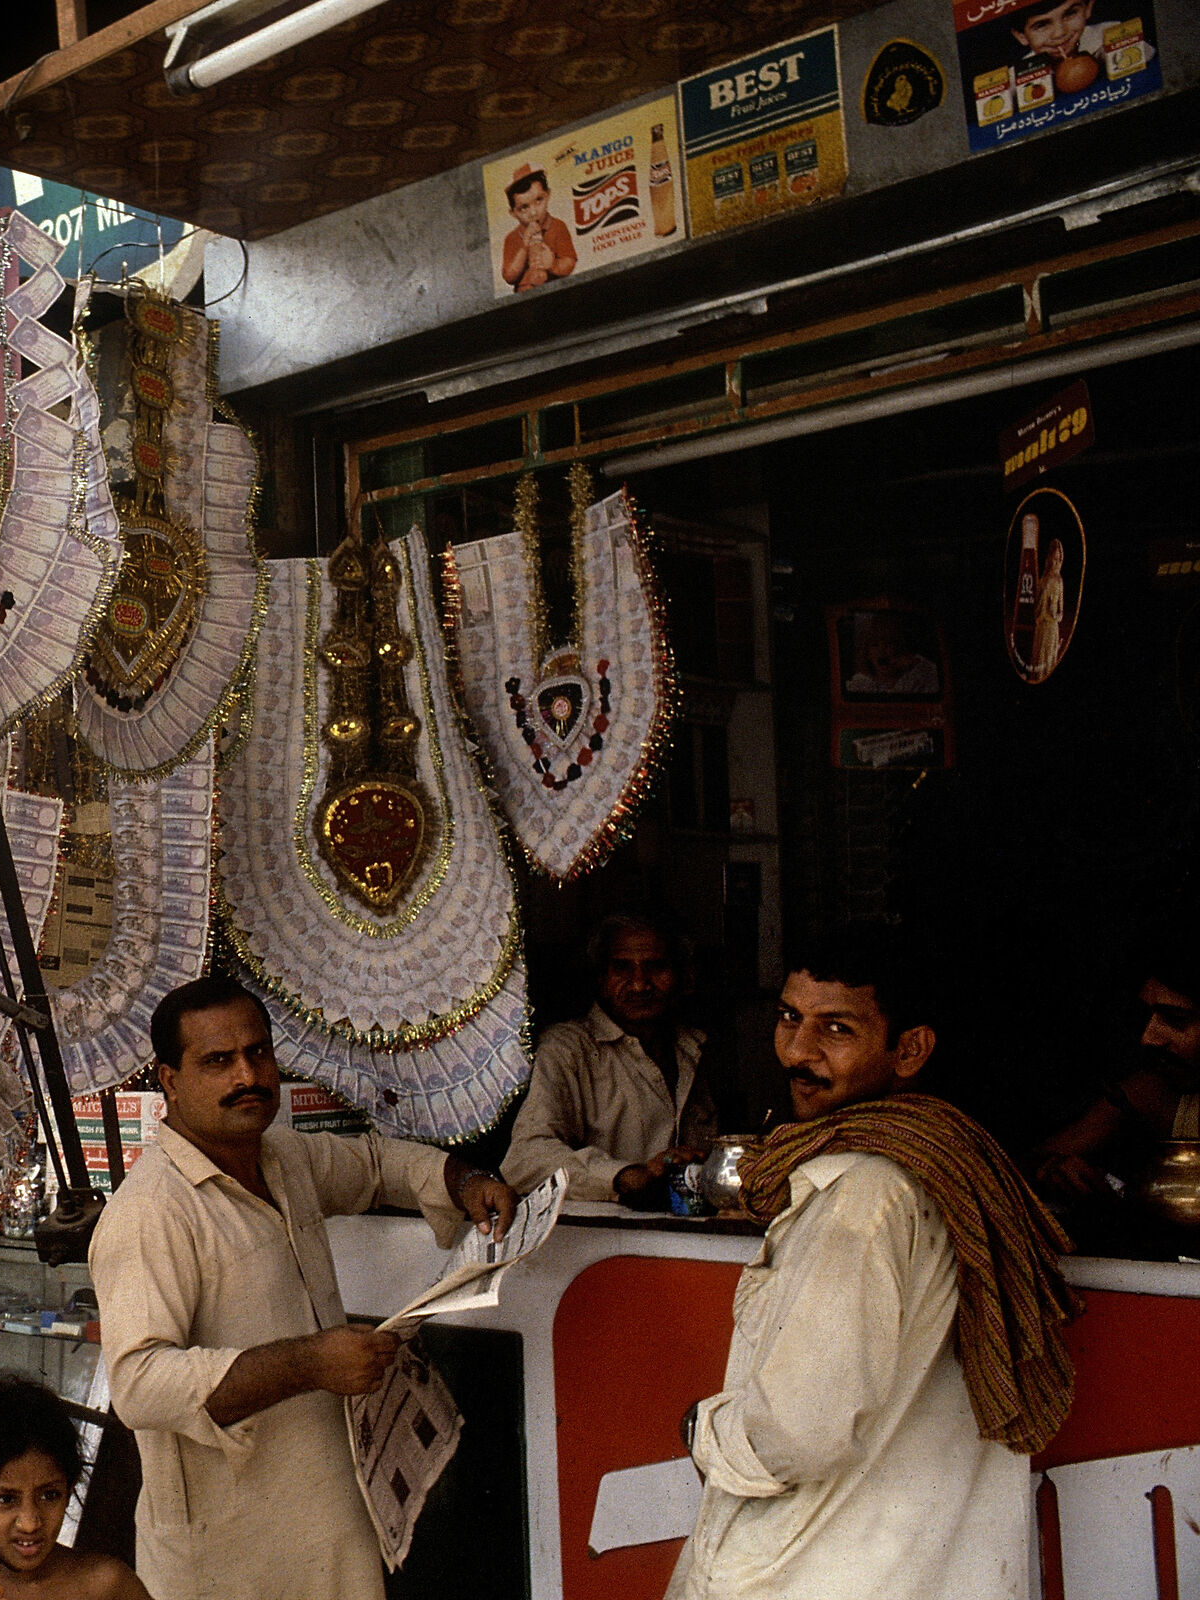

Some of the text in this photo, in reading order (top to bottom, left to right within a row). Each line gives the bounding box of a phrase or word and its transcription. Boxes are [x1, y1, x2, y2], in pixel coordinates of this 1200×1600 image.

[708, 52, 805, 110] BEST
[573, 135, 634, 166] MANGO
[584, 148, 634, 175] JUICE
[580, 176, 630, 221] TOPS
